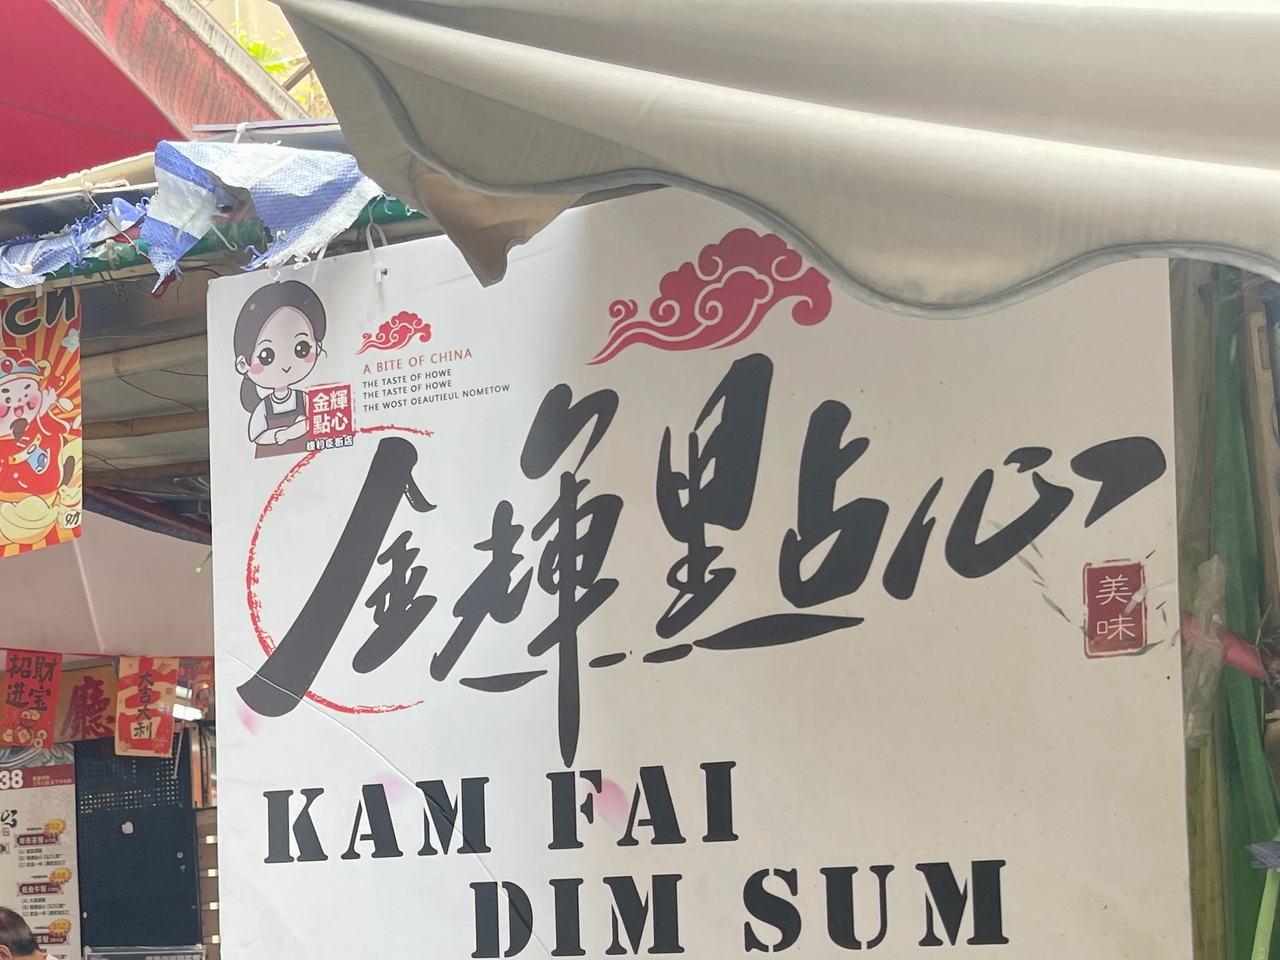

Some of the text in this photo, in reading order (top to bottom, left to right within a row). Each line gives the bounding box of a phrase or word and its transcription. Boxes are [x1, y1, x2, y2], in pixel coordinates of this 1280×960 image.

[363, 348, 472, 375] A BITE OF CHINA
[363, 369, 452, 388] THE TASTE OF HOWE
[363, 380, 452, 399] THE TASTE OF HOWE
[312, 389, 348, 412] 金輝
[363, 403, 379, 412] THE
[313, 412, 349, 435] 點心
[237, 353, 1166, 765] 金輝點心
[6, 654, 58, 683] 招財
[133, 670, 154, 739] 大吉大利
[263, 761, 739, 863] KAM FAI
[470, 860, 1009, 959] DIM SUM
